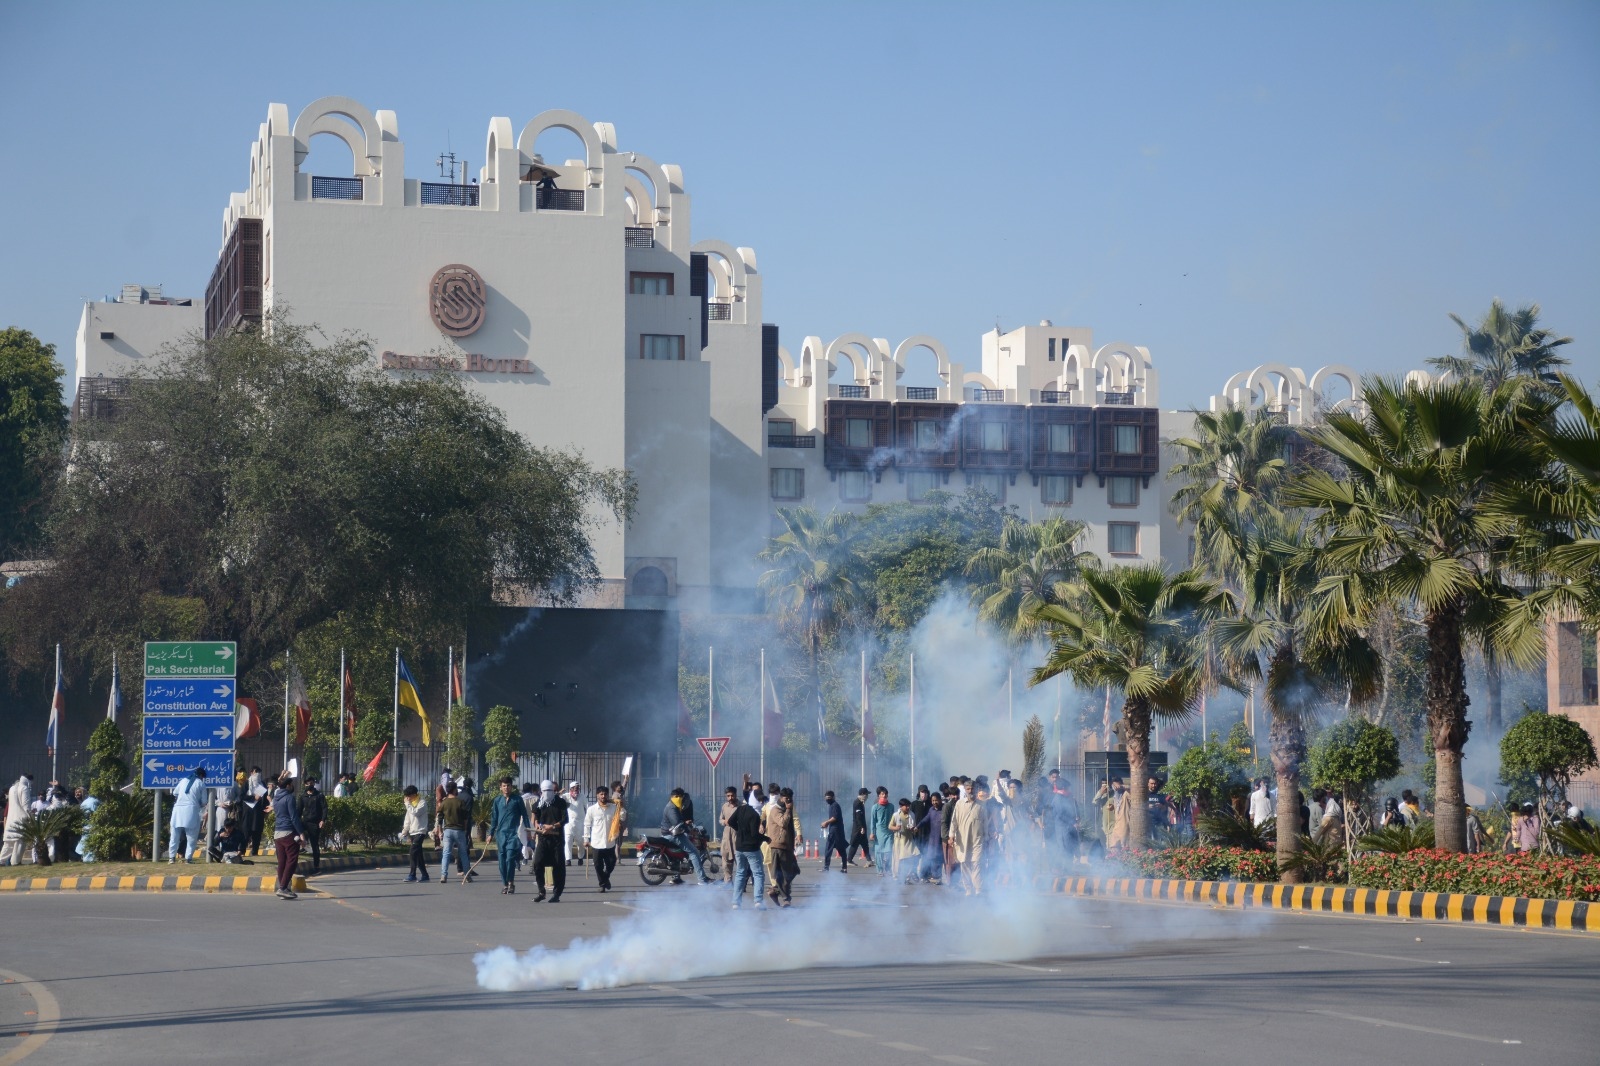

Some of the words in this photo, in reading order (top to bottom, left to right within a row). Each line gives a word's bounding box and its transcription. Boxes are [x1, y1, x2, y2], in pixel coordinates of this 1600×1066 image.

[465, 353, 534, 373] HOTEL
[147, 665, 167, 674] Pak
[169, 665, 226, 674] Secretariat
[146, 701, 207, 710] Constitution
[210, 701, 228, 710] Ave
[146, 739, 181, 748] Serena
[184, 738, 211, 747] Hotel
[201, 775, 231, 784] arket
